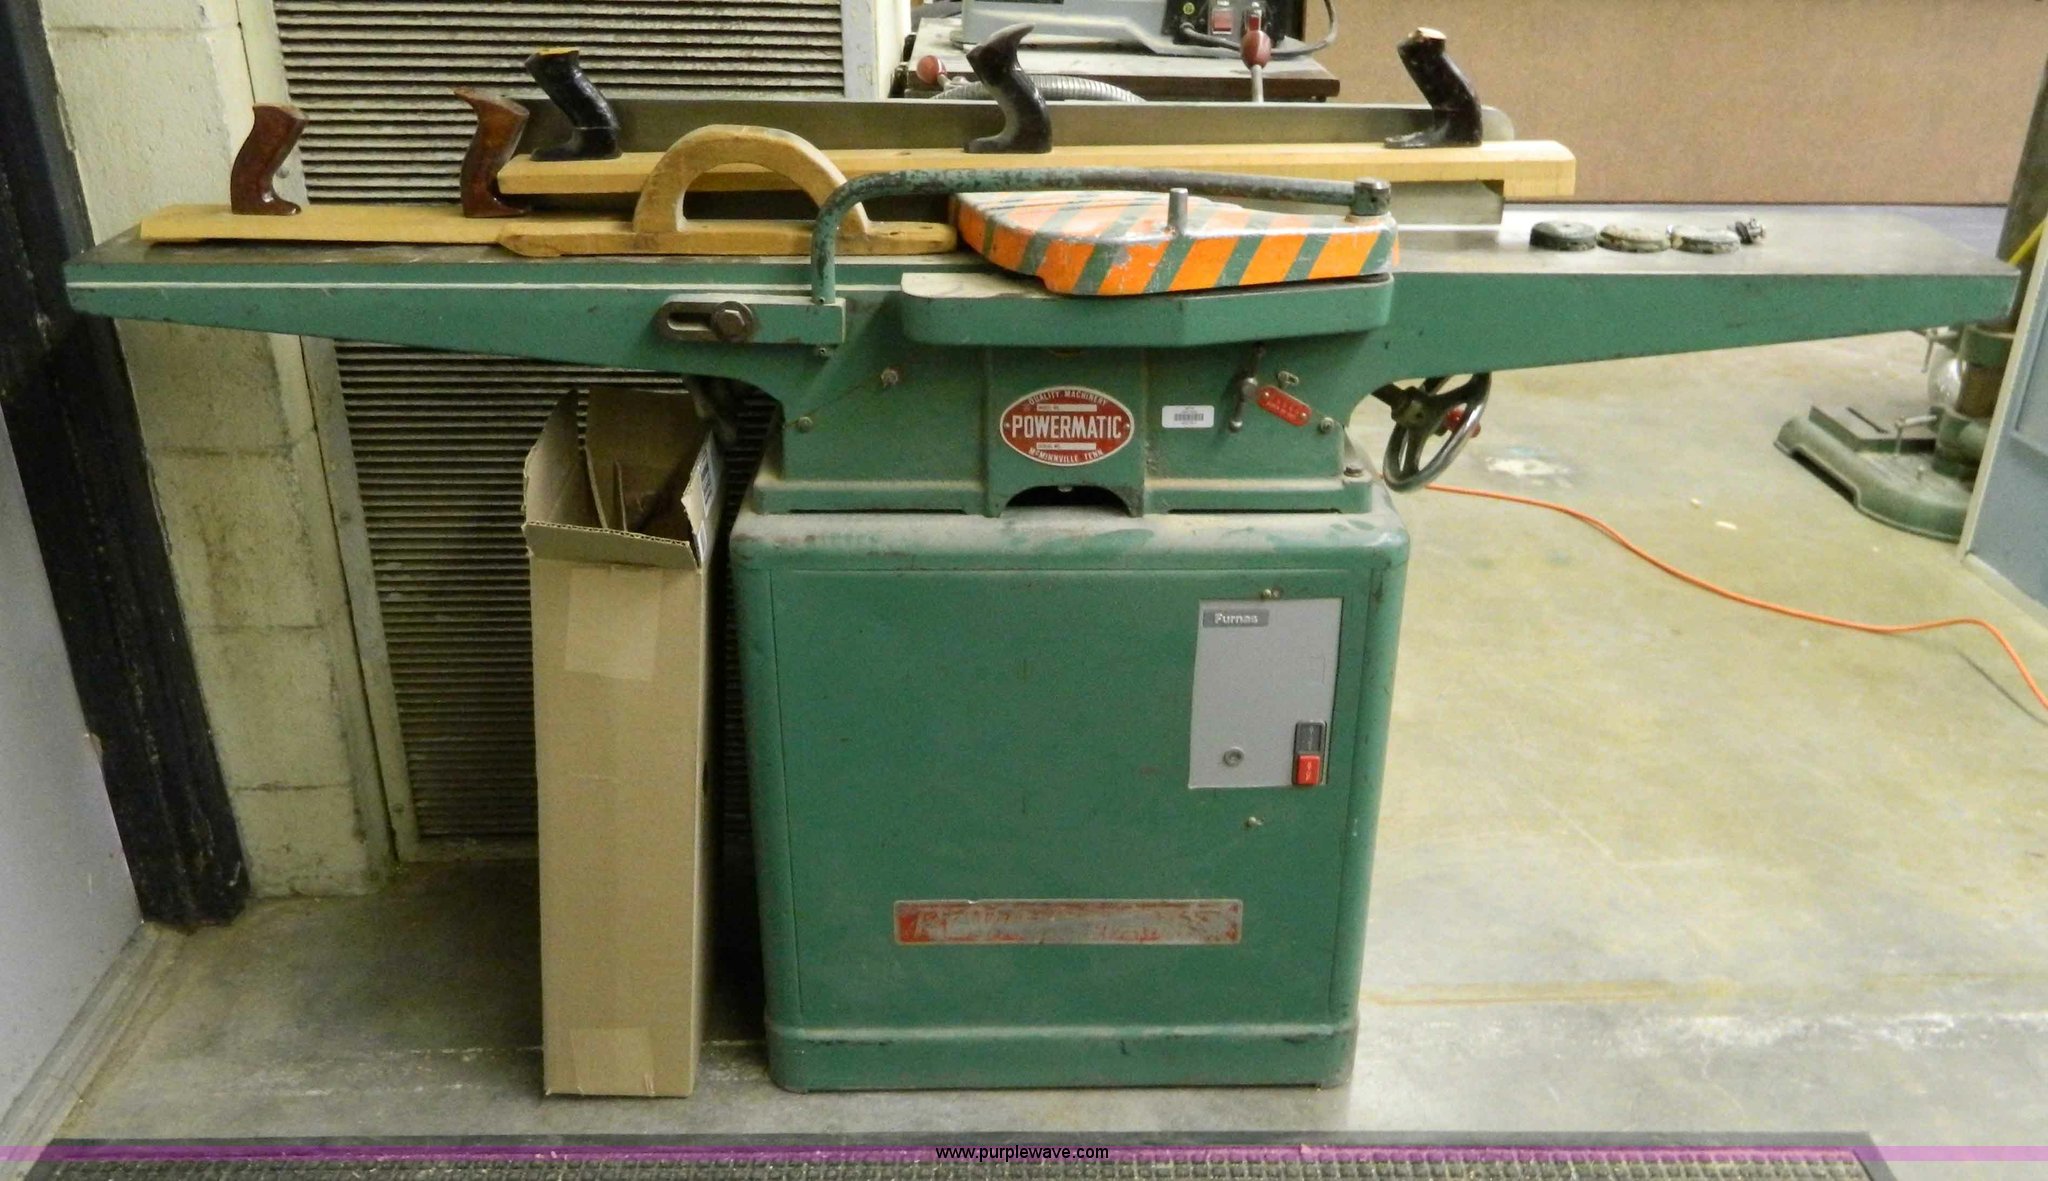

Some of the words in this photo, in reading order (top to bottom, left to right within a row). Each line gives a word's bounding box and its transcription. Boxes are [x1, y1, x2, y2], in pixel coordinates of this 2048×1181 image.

[1028, 391, 1060, 406] QUALITY
[1064, 390, 1107, 406] MACHINERY
[1012, 415, 1122, 439] POWERMATIC
[1215, 613, 1258, 625] Furnas
